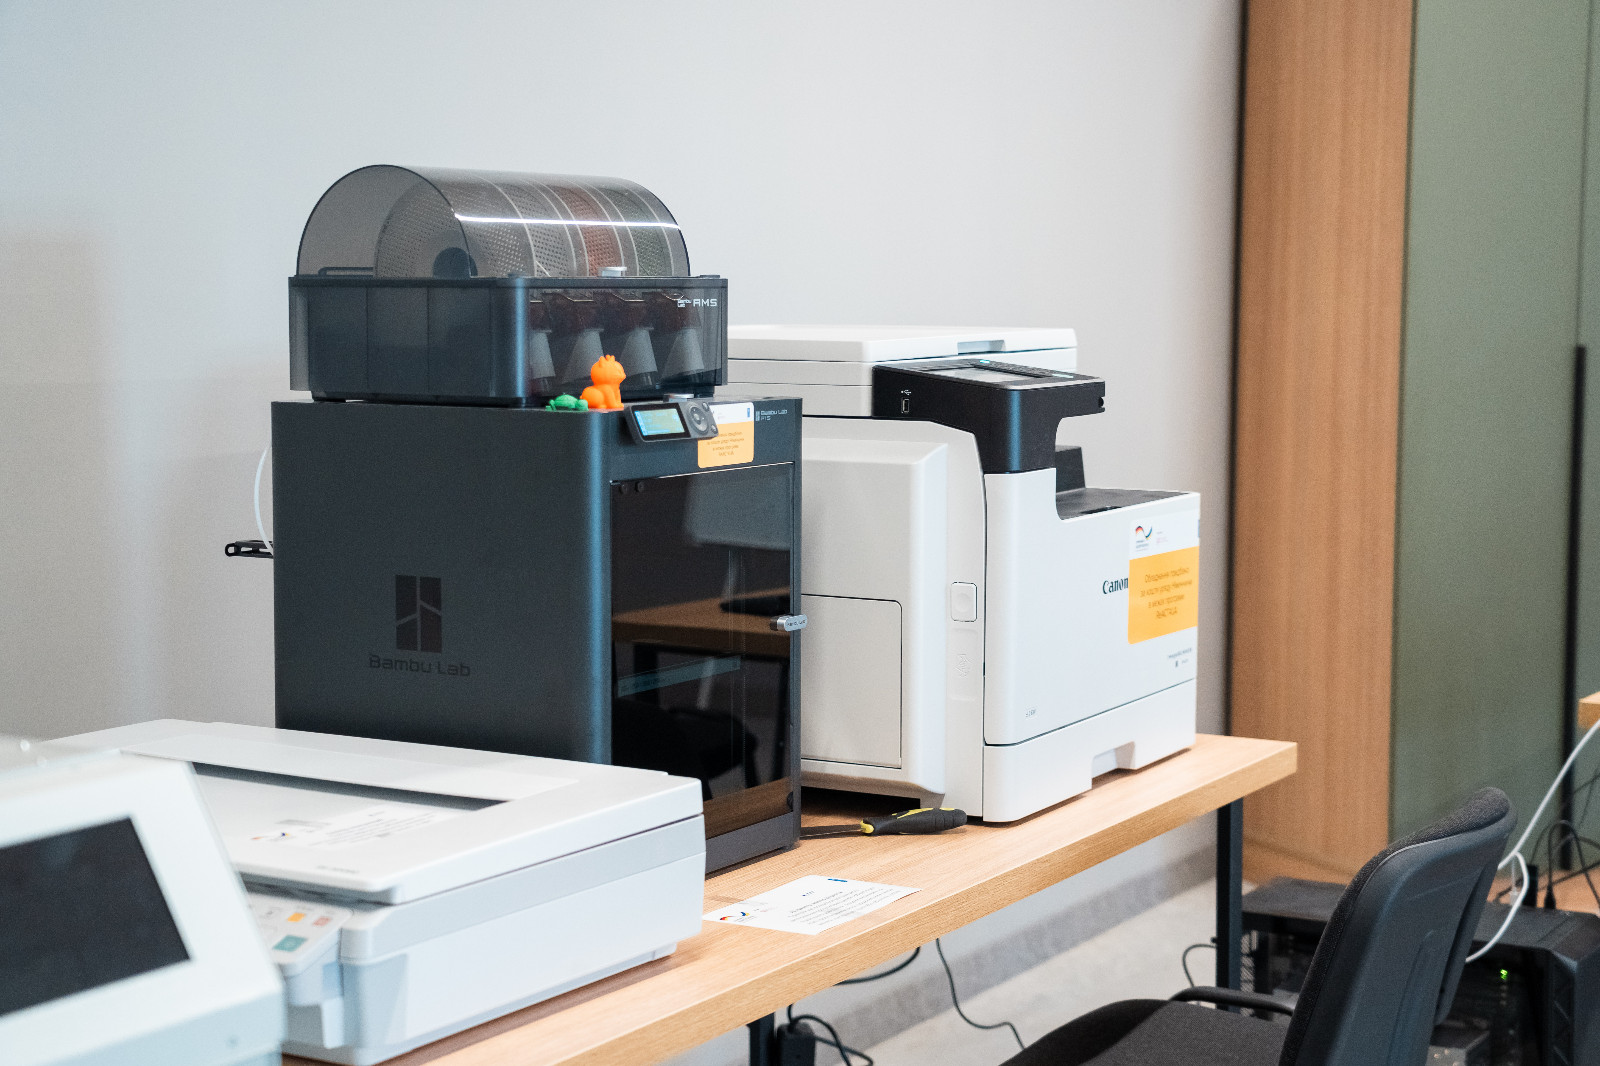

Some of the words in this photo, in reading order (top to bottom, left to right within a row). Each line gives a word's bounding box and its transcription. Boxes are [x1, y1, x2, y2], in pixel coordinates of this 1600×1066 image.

[692, 298, 718, 307] AMS
[1102, 578, 1128, 594] Canon
[370, 654, 432, 673] Bambu
[438, 662, 470, 676] Lab
